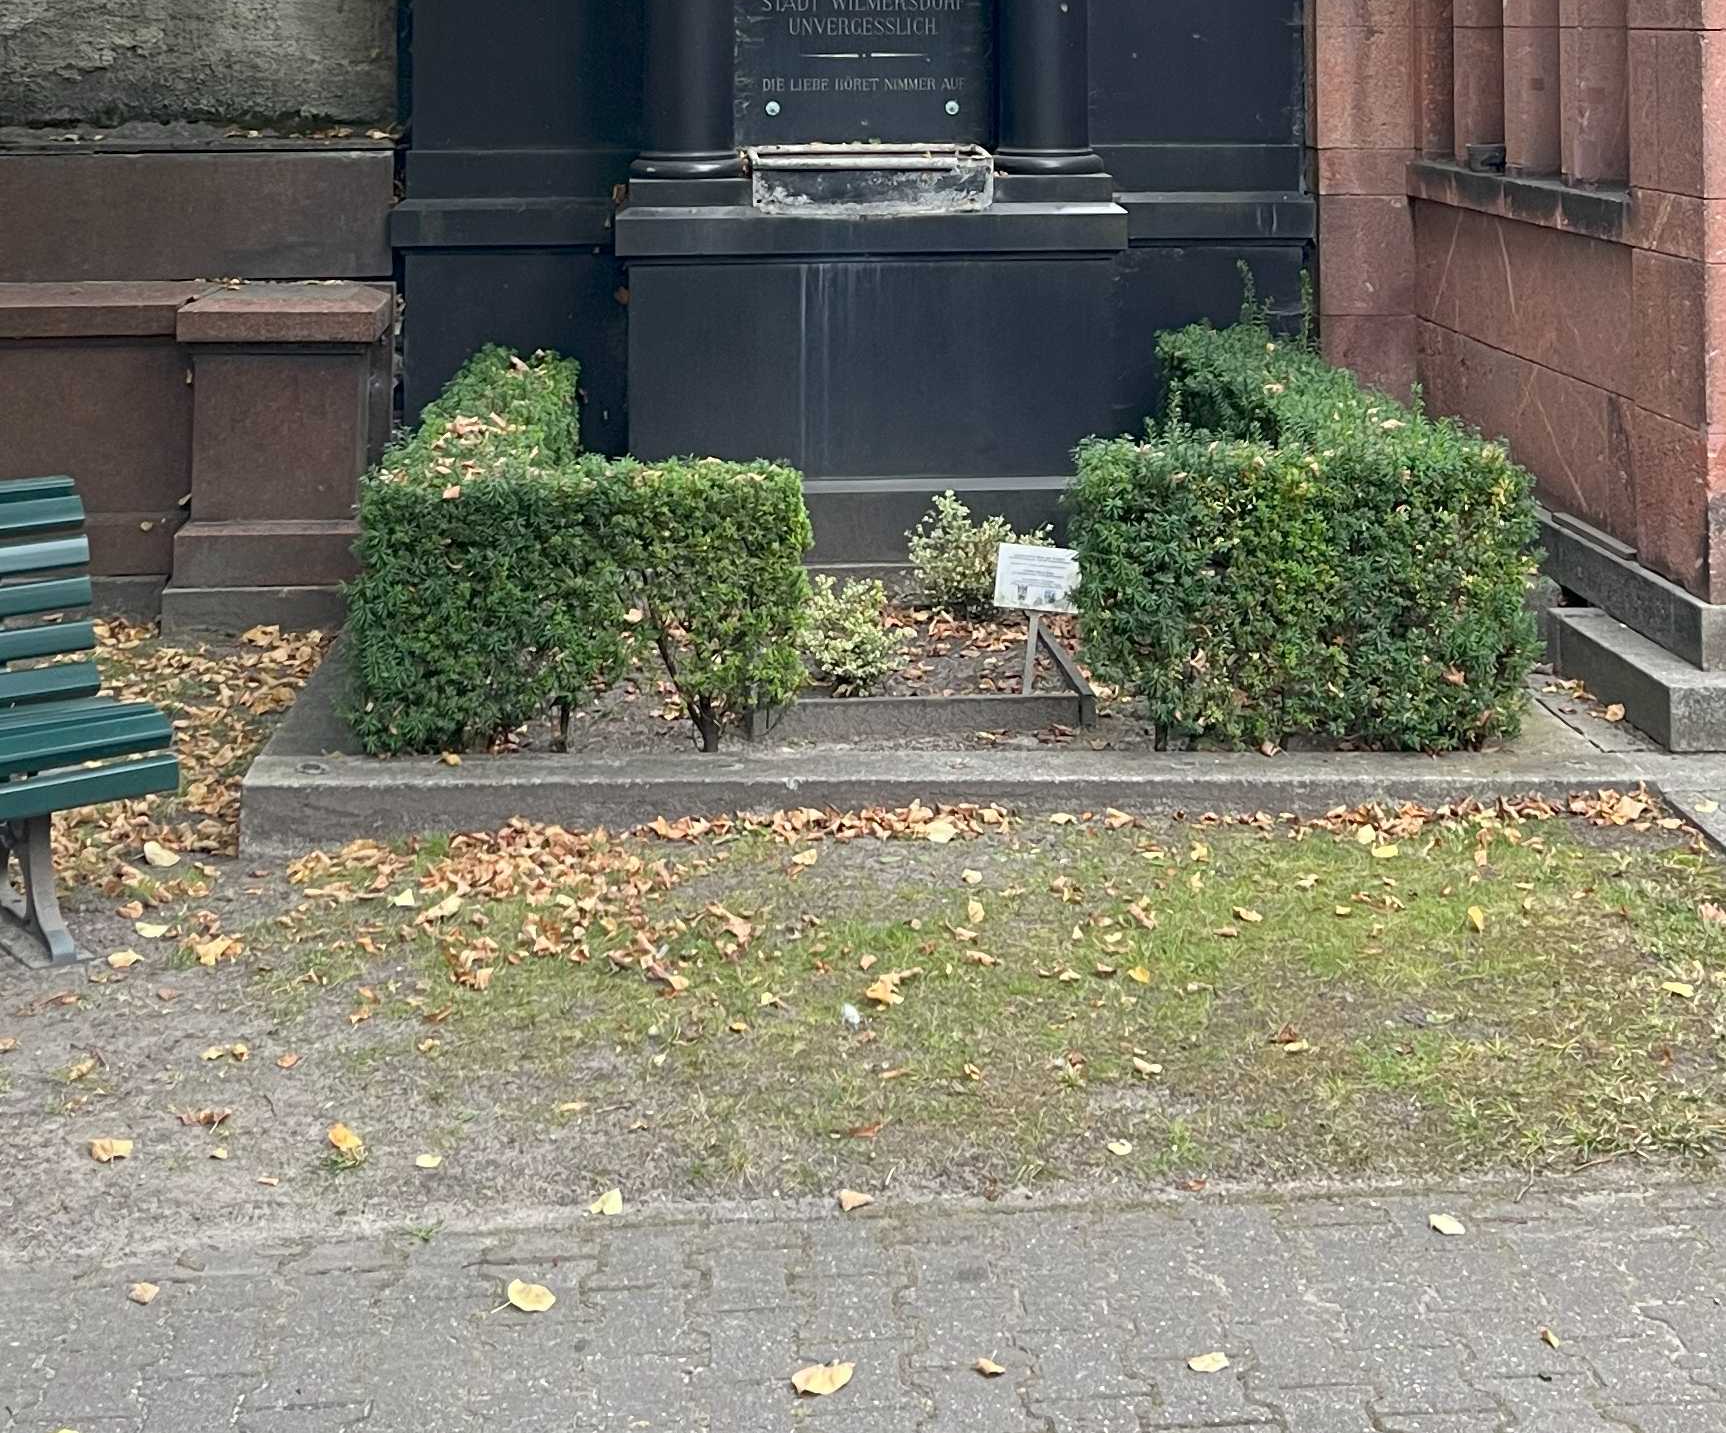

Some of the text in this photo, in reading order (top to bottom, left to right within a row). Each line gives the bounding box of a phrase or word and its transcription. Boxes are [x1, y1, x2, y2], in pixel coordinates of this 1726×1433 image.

[762, 77, 785, 92] DIE
[790, 78, 830, 92] LIEBE
[884, 77, 936, 91] NIMMER
